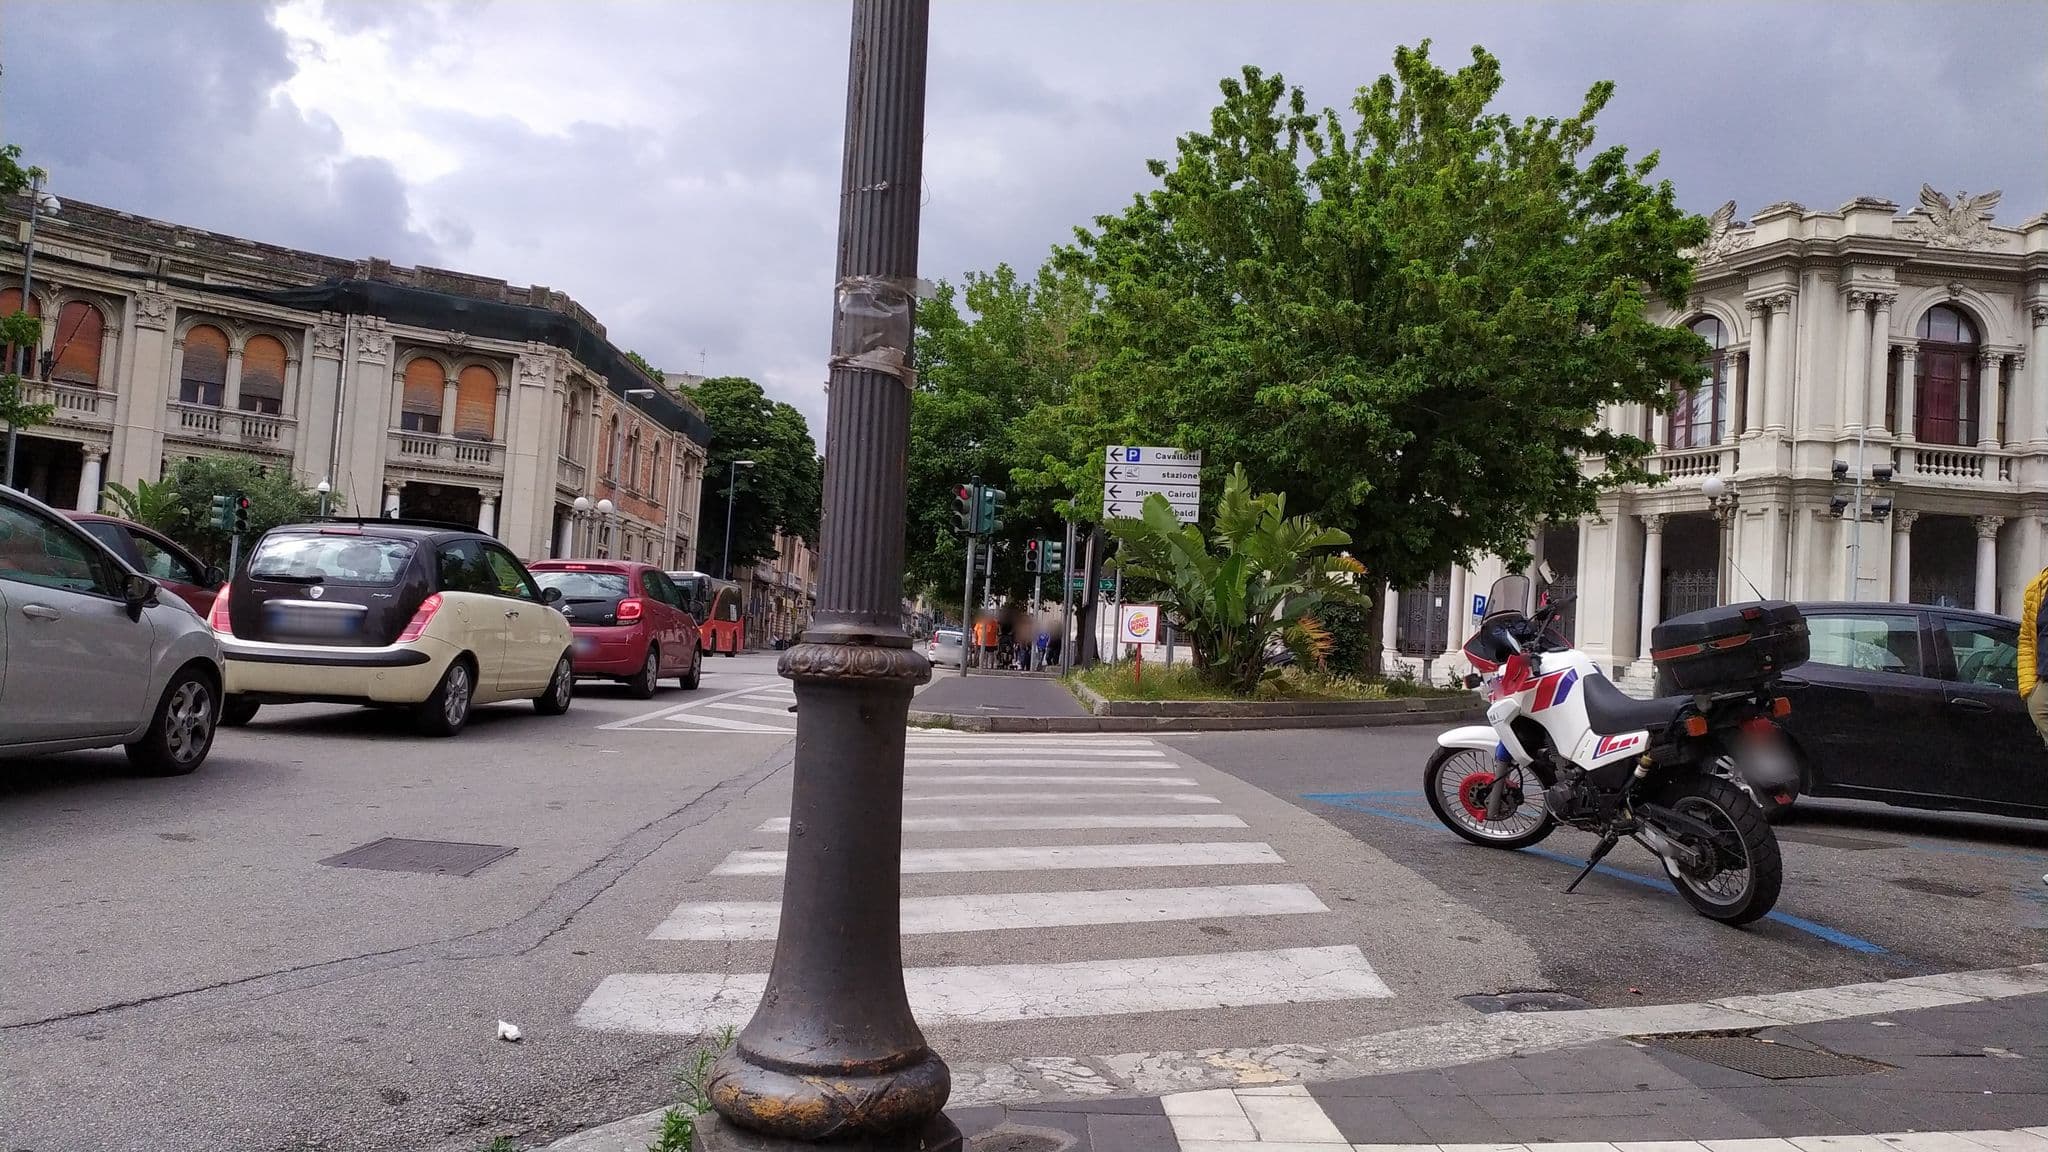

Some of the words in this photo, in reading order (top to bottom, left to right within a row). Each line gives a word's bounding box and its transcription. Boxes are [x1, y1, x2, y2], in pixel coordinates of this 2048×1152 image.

[1129, 450, 1138, 460] P
[1155, 452, 1199, 461] Cavallotti
[1162, 471, 1198, 479] stazione
[1168, 490, 1197, 498] Cairoli
[1475, 597, 1484, 613] P
